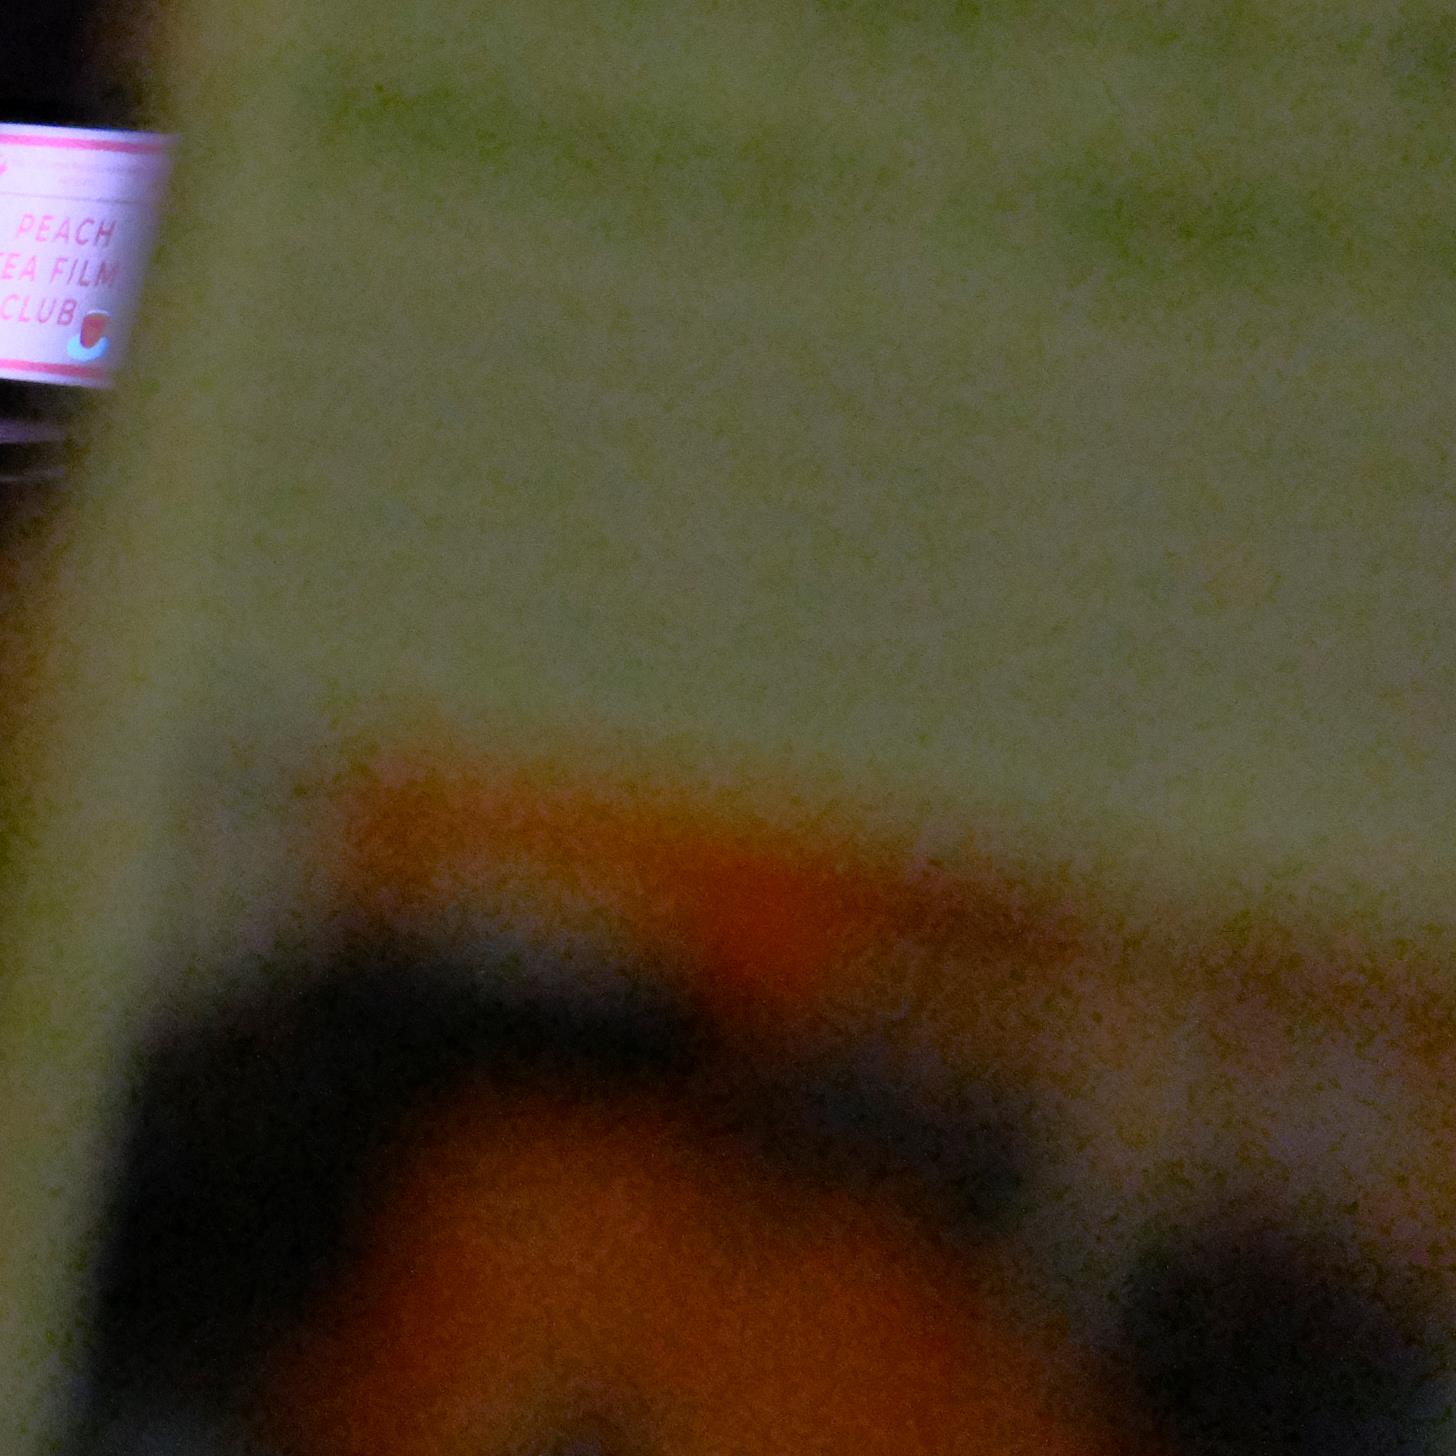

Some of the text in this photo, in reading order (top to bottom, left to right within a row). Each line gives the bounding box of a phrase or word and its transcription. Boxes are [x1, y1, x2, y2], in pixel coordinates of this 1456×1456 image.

[17, 215, 116, 247] PEACH
[50, 257, 120, 286] FILM
[0, 294, 77, 327] CLUB
